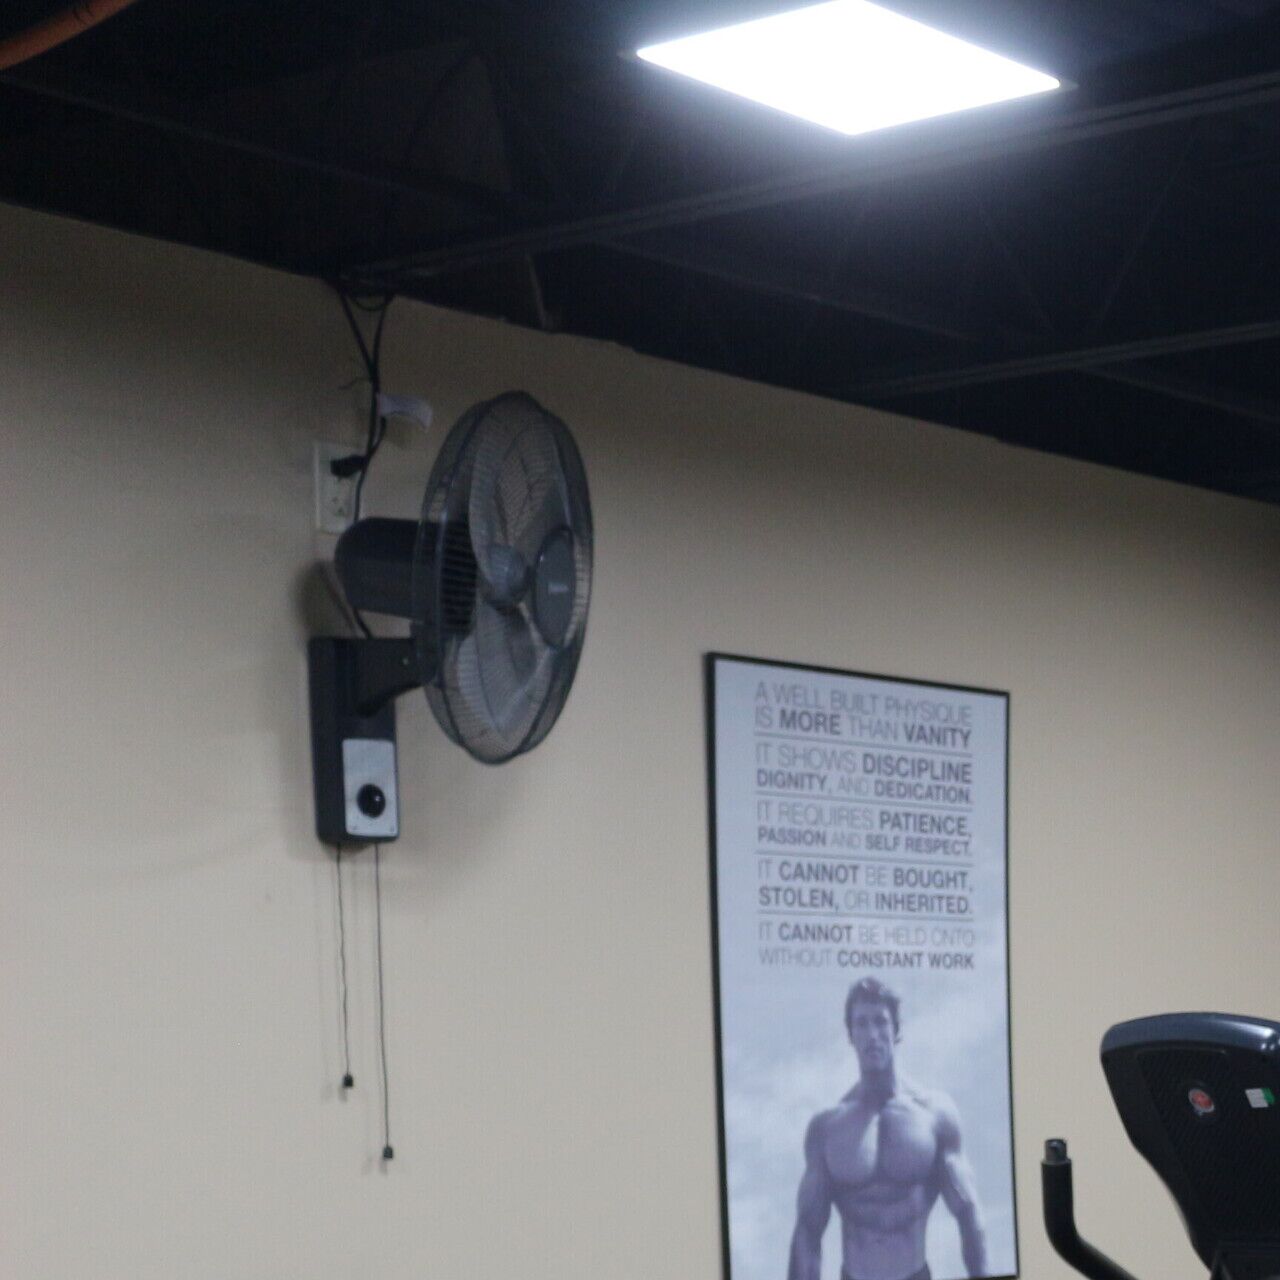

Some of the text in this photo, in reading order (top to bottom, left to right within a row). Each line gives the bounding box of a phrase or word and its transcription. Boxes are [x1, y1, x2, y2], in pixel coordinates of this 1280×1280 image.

[756, 681, 972, 724] A WELL BUILT PHYSIQUE
[755, 705, 972, 748] IS MORE THAN VANITY
[757, 742, 972, 784] IT SHOWS DISCIPLINE
[837, 778, 869, 795] AND
[757, 800, 972, 838] IT REQUIRES PATIENCE,
[758, 826, 826, 846] PASSION
[831, 831, 861, 849] AND
[866, 834, 900, 851] SELF
[758, 859, 973, 892] IT CANNOT BE BOUGHT,
[759, 885, 839, 912] STOLEN,
[844, 889, 868, 909] OR
[759, 922, 772, 941] IT
[778, 922, 853, 943] CANNOT
[858, 926, 880, 945] BE
[759, 948, 974, 970] WITHOUT CONSTANT WORK
